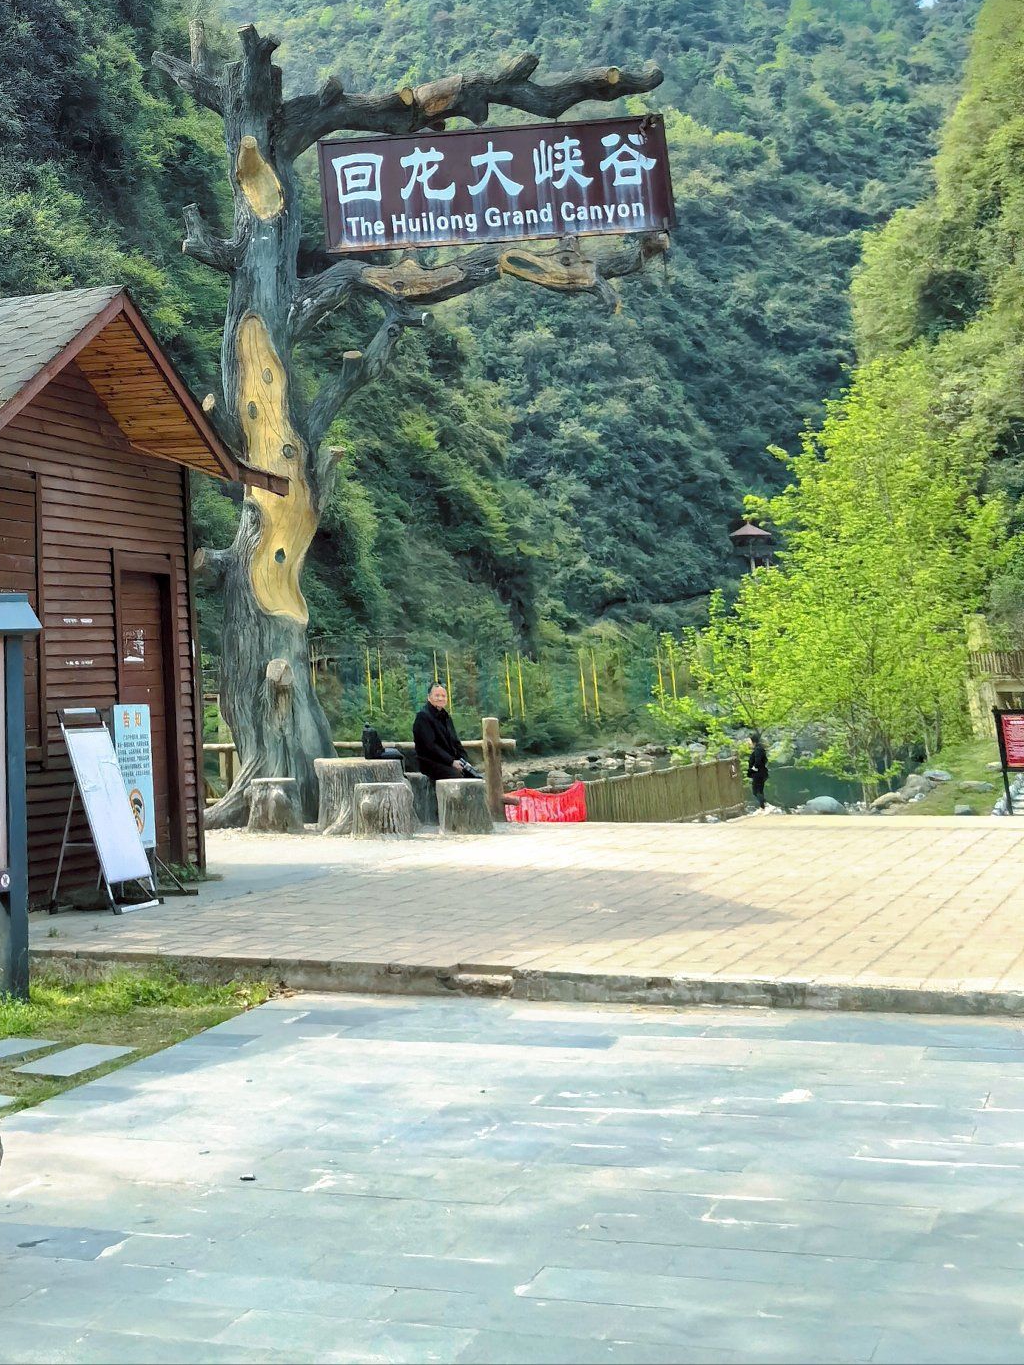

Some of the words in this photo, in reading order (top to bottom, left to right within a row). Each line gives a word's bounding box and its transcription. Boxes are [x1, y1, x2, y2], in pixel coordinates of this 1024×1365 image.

[331, 134, 657, 204] 回龙大峡谷
[346, 216, 386, 237] The
[391, 211, 478, 234] Huilong
[484, 202, 554, 228] Grand
[560, 201, 646, 224] Canyon
